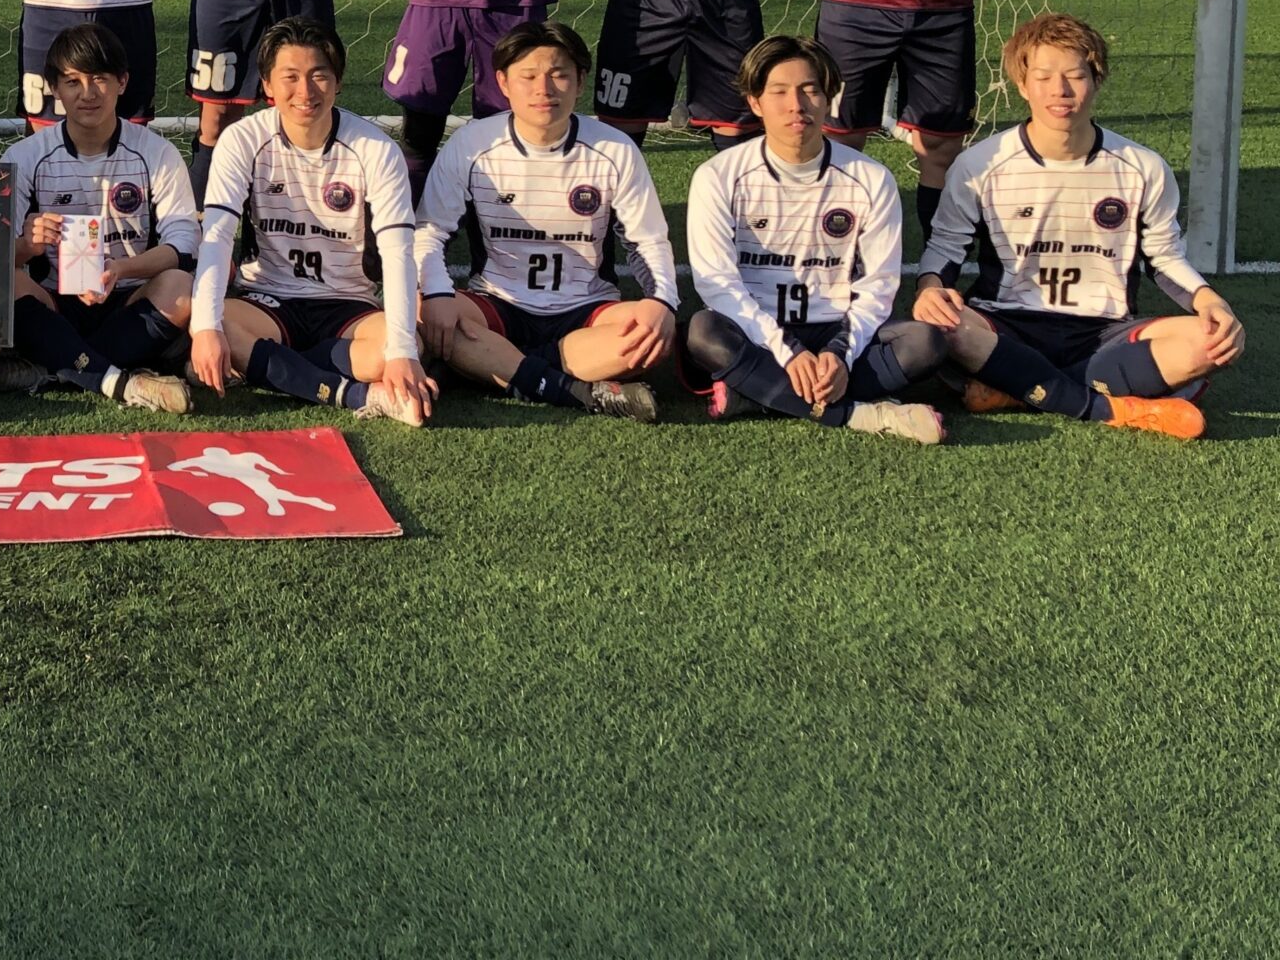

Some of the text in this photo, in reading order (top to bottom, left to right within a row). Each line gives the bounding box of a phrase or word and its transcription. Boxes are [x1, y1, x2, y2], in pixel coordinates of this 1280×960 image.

[190, 49, 237, 93] 56
[597, 67, 631, 108] 36
[528, 253, 563, 291] 21
[1039, 267, 1081, 307] 42
[776, 283, 808, 324] 19
